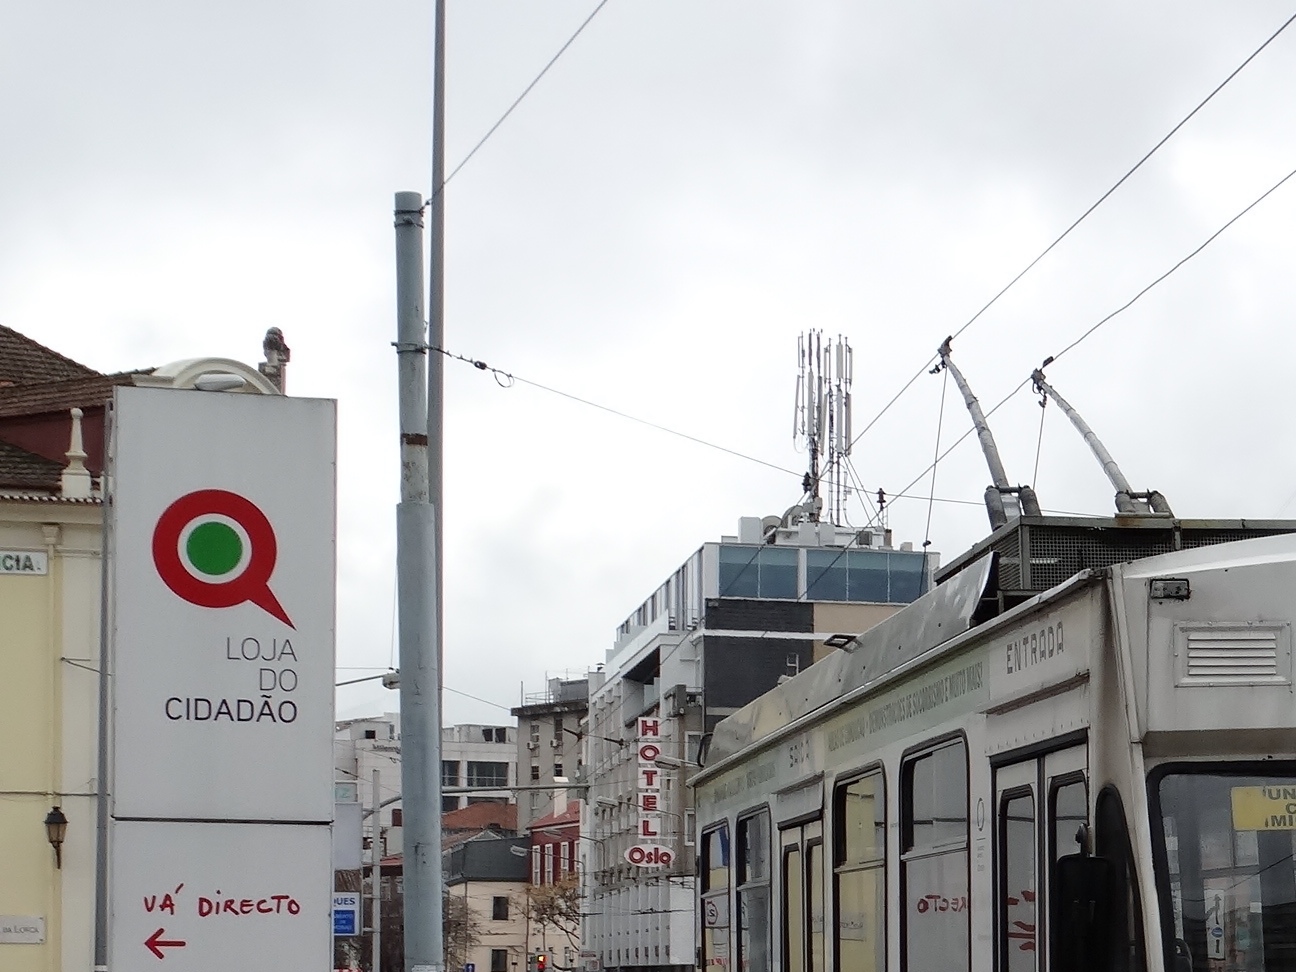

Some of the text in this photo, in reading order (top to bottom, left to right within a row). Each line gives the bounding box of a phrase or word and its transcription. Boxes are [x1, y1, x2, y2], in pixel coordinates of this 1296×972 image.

[0, 554, 35, 571] CIA
[226, 637, 298, 662] LOJA
[1006, 621, 1064, 675] ENTRADA
[259, 668, 298, 692] DO
[165, 694, 298, 723] CIDADÃO
[639, 719, 660, 837] HOTEL
[628, 846, 671, 865] Oslo
[144, 883, 184, 916] VÁ
